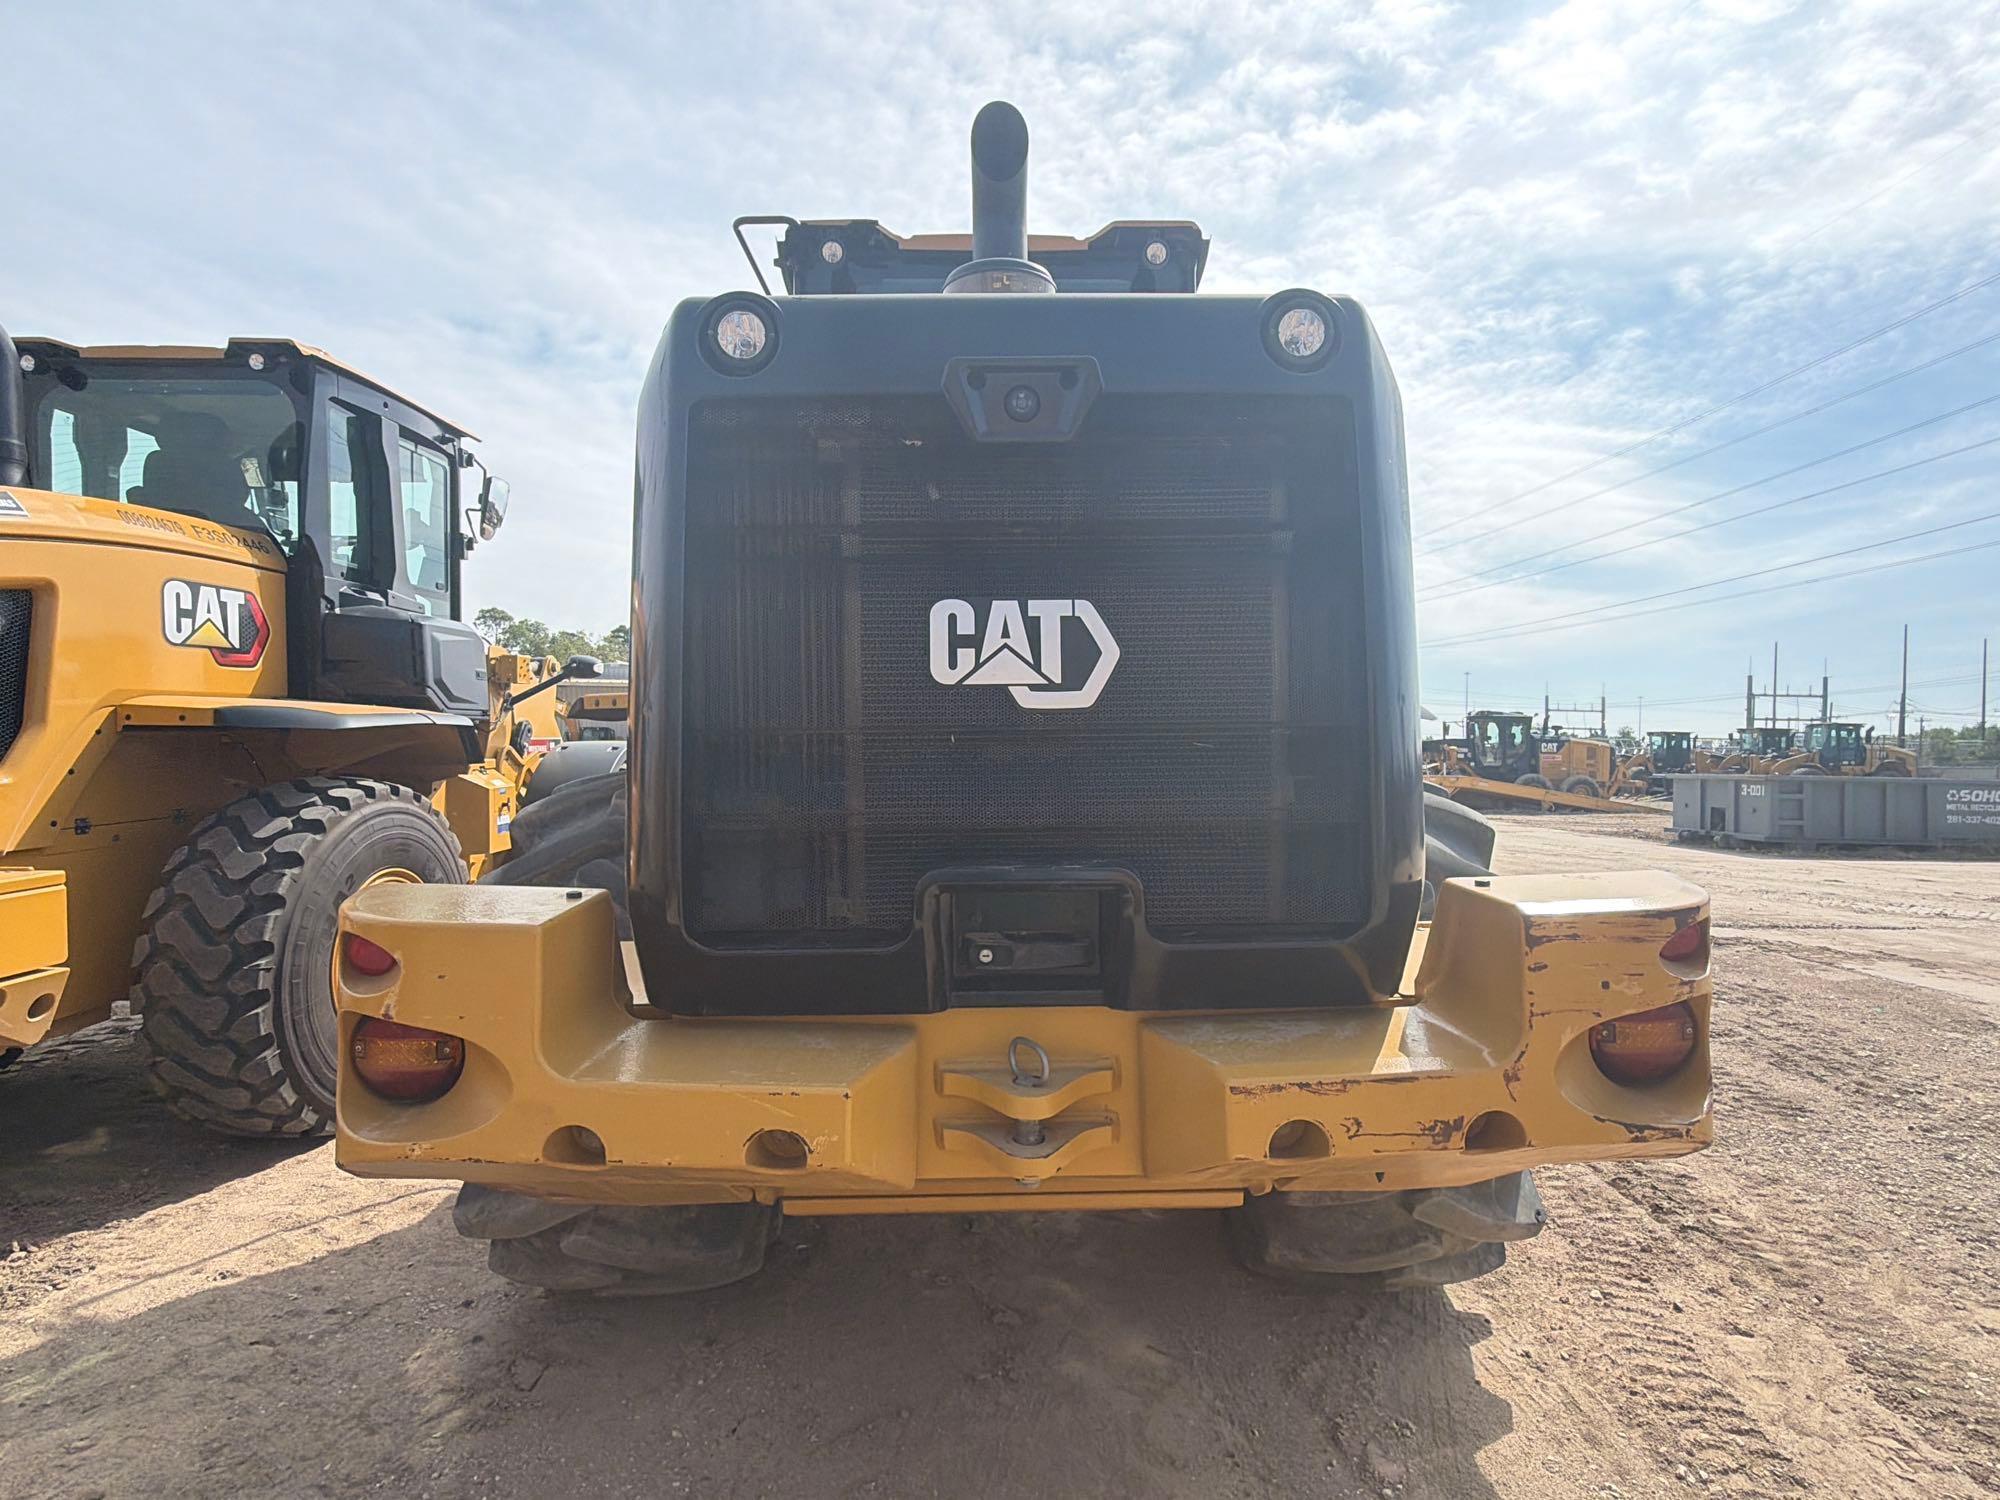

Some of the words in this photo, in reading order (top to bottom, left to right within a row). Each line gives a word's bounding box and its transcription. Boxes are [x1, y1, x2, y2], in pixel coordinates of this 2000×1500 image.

[163, 580, 244, 649] CAT
[929, 598, 1073, 685] CAT
[1541, 742, 1558, 753] CAT
